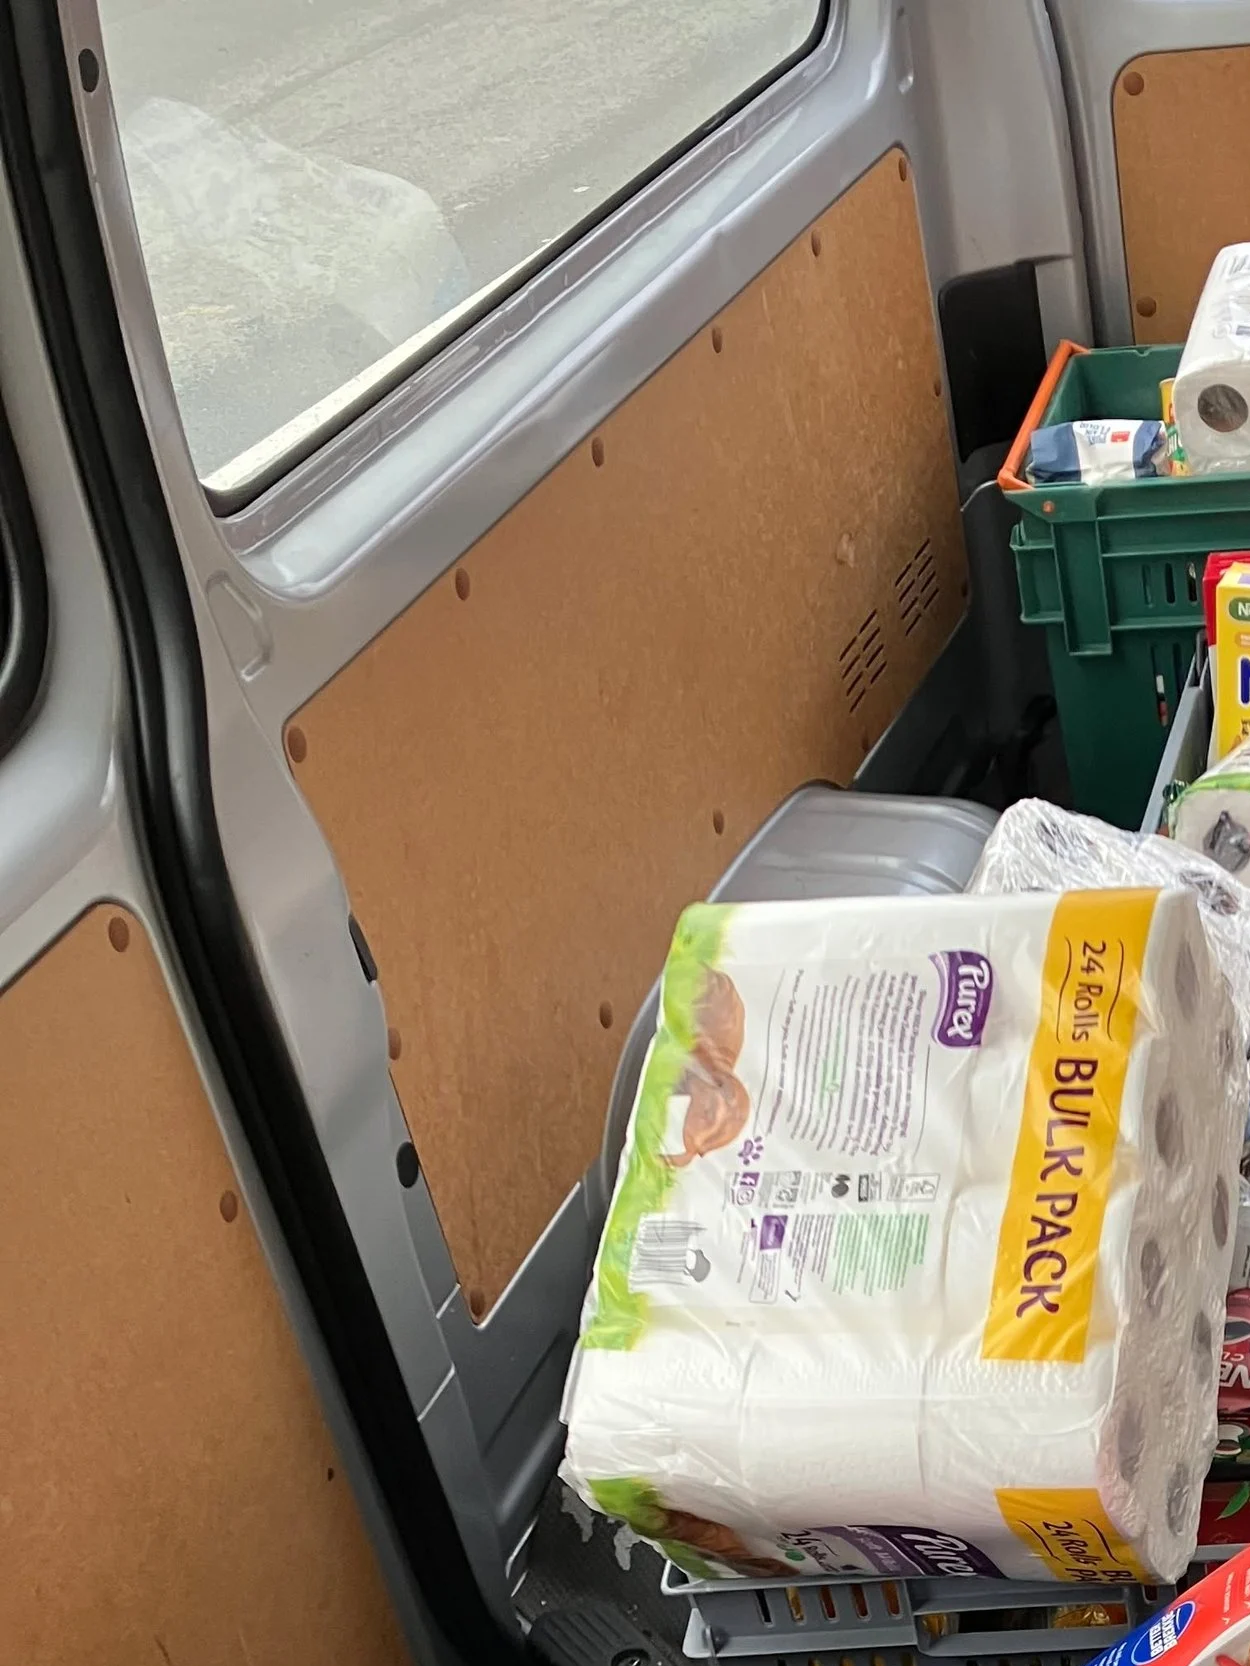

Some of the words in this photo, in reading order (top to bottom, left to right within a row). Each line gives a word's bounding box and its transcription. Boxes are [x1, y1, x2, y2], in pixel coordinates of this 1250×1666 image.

[1081, 940, 1106, 974] 24
[947, 959, 991, 1041] Purex
[1072, 980, 1102, 1042] Rolls
[1039, 1056, 1098, 1181] BULK
[1015, 1193, 1077, 1318] PACK
[1043, 1521, 1066, 1537] 24
[1060, 1535, 1098, 1566] Rolls
[1149, 1622, 1162, 1658] BETTER
